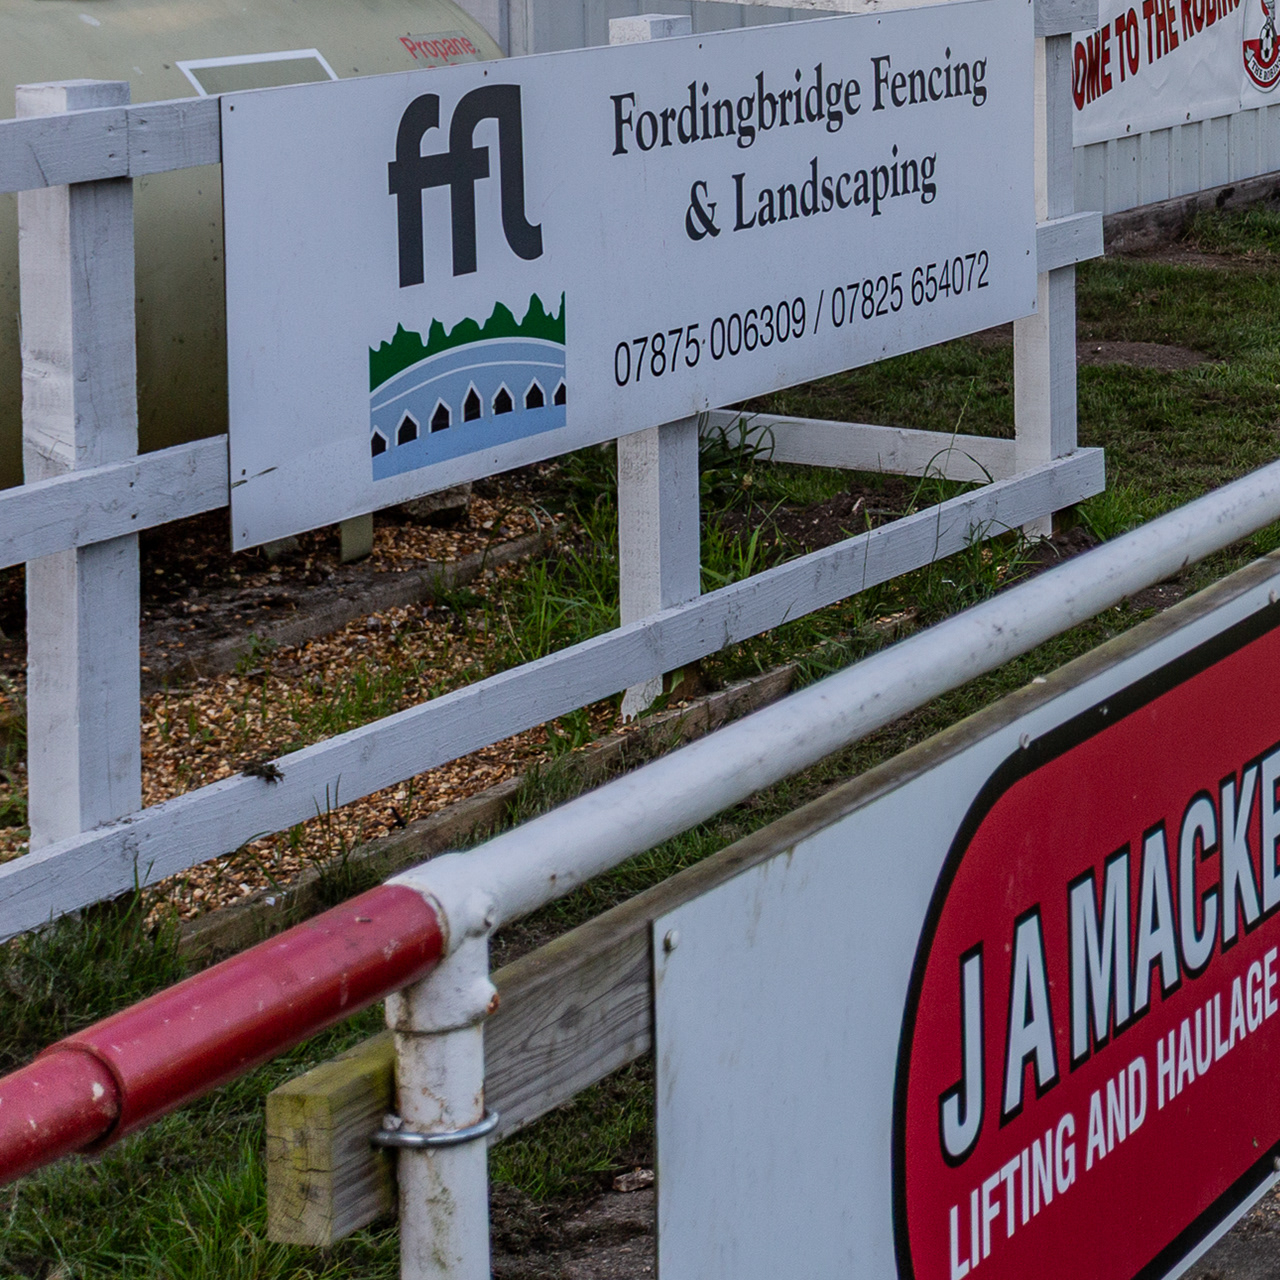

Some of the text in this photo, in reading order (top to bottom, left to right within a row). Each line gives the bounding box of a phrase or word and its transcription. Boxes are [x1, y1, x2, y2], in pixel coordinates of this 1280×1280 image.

[398, 36, 476, 62] Propane
[1115, 7, 1140, 82] TO
[610, 46, 988, 156] Fordingbridge Fencing
[685, 143, 938, 241] & Landscaping
[614, 250, 990, 387] 07875 006309 / 07825 654072
[939, 941, 984, 1169] J
[1000, 903, 1060, 1130] A
[948, 1112, 1077, 1280] LIFTING
[1085, 1056, 1148, 1172] AND
[1156, 947, 1279, 1111] HAULAGE
